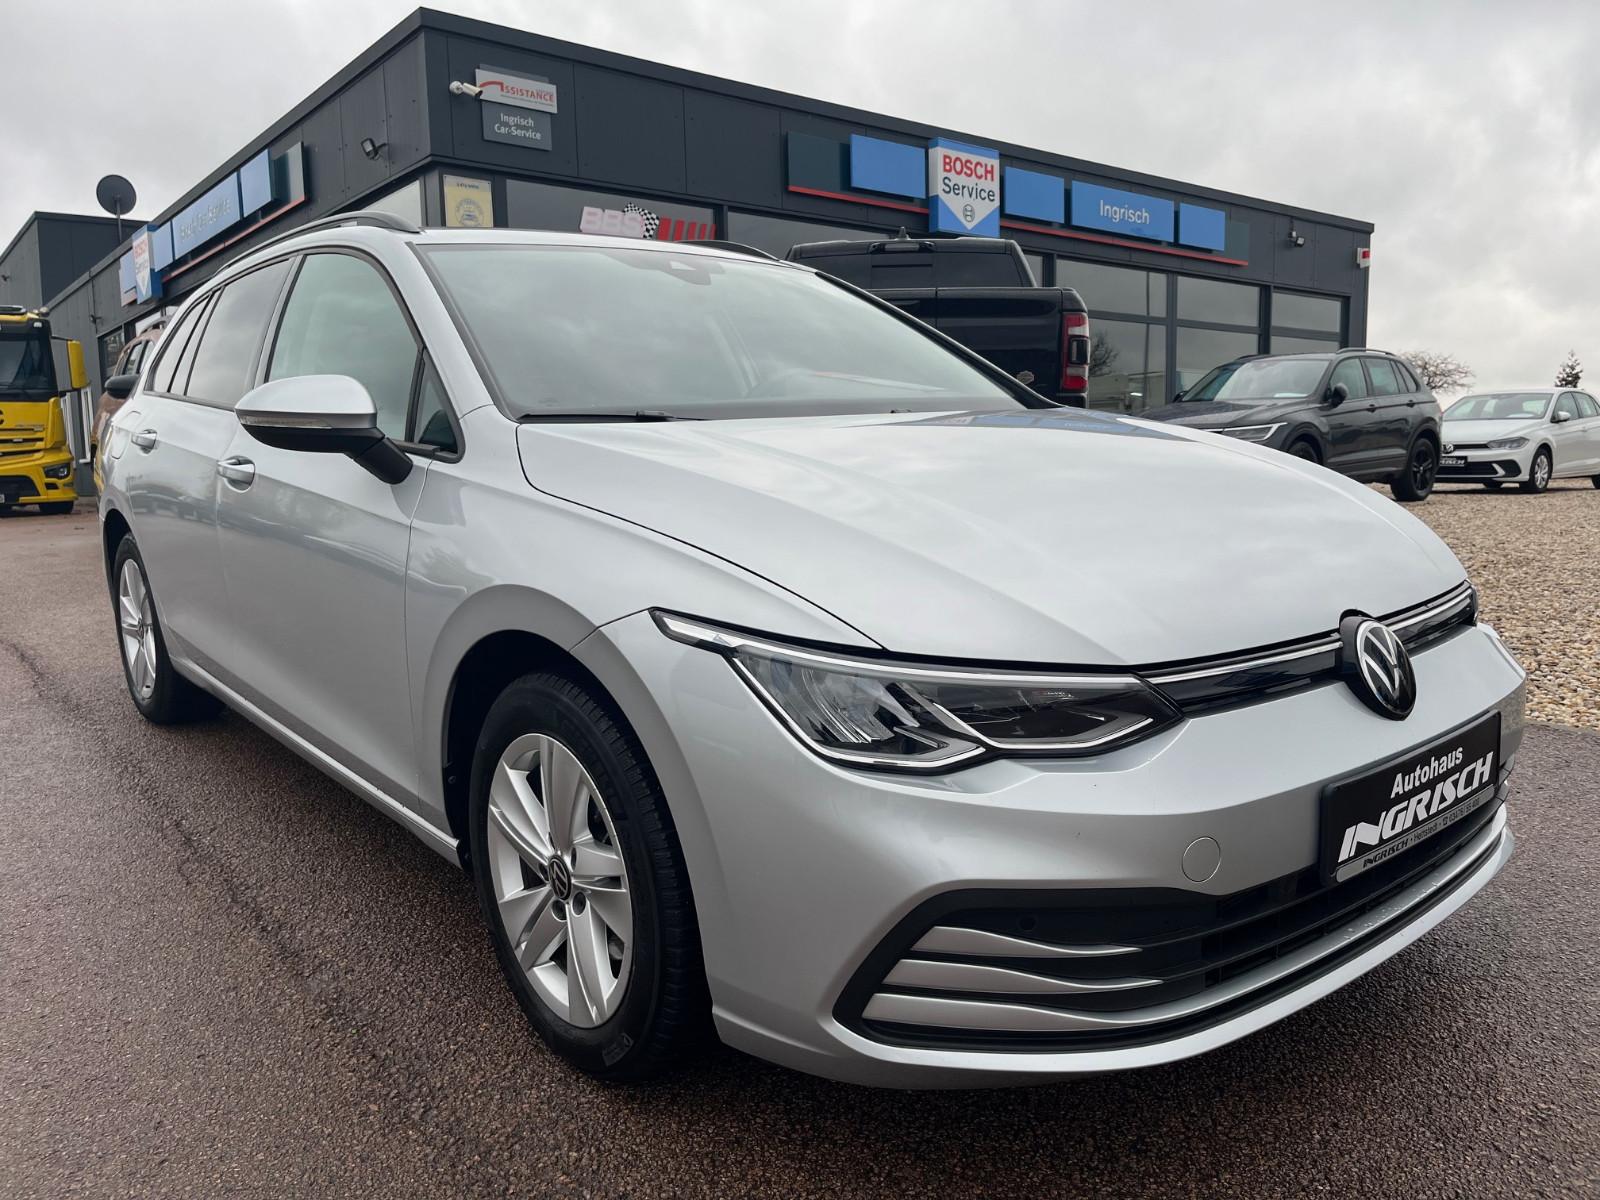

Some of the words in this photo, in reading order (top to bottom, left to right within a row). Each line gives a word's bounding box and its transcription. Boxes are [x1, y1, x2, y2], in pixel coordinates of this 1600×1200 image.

[500, 113, 534, 127] Ingrisch
[943, 154, 994, 182] BOSCH
[942, 176, 996, 202] Service
[1100, 199, 1150, 225] Ingrisch
[1390, 747, 1463, 799] Autohaus
[1338, 751, 1494, 863] INGRISCH
[1363, 838, 1409, 868] INGRISCH
